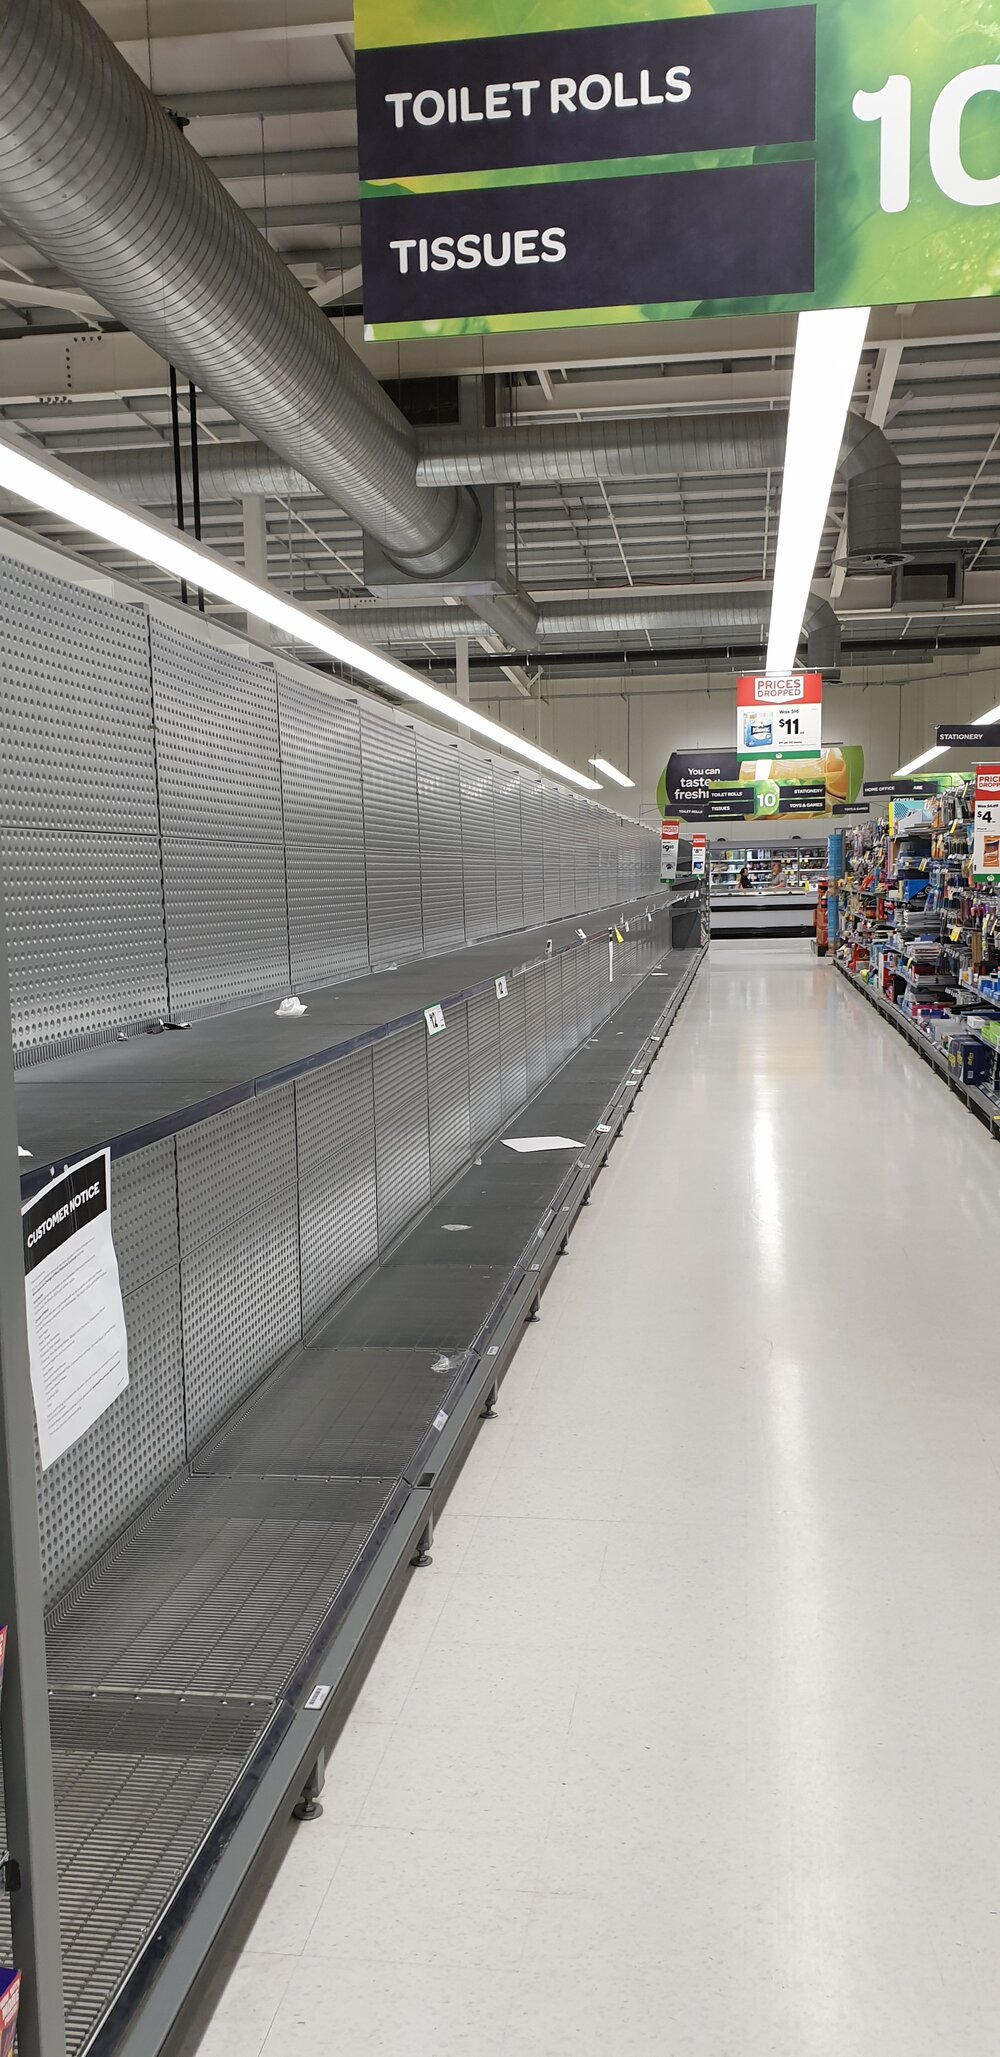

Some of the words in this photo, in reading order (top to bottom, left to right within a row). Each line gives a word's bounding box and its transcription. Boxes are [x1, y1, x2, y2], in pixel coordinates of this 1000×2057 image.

[385, 80, 540, 128] TOILET
[550, 65, 692, 114] ROLLS
[389, 227, 567, 274] TISSUES
[757, 679, 801, 689] PRICES
[757, 689, 801, 698] DROPPED
[779, 718, 799, 734] $11
[680, 777, 712, 788] taste
[756, 793, 776, 807] 10
[27, 1204, 69, 1248] CUSTOMER
[70, 1181, 100, 1213] NOTICE
